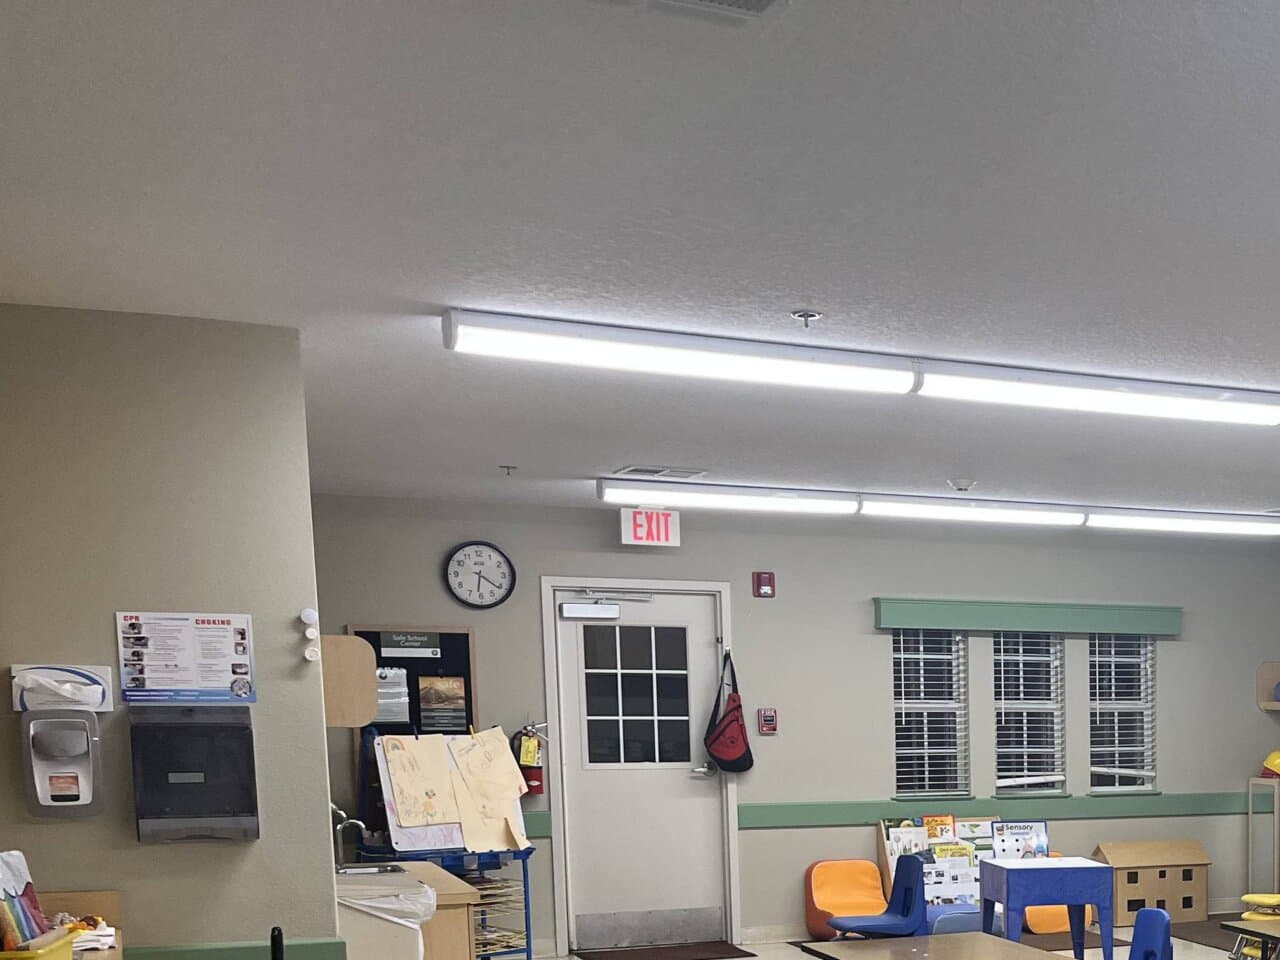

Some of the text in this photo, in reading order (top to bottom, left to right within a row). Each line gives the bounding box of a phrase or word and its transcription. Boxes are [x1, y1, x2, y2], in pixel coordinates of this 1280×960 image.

[632, 511, 671, 542] EXIT
[496, 560, 502, 568] 2
[478, 592, 484, 600] 6
[195, 618, 231, 626] CHOKING
